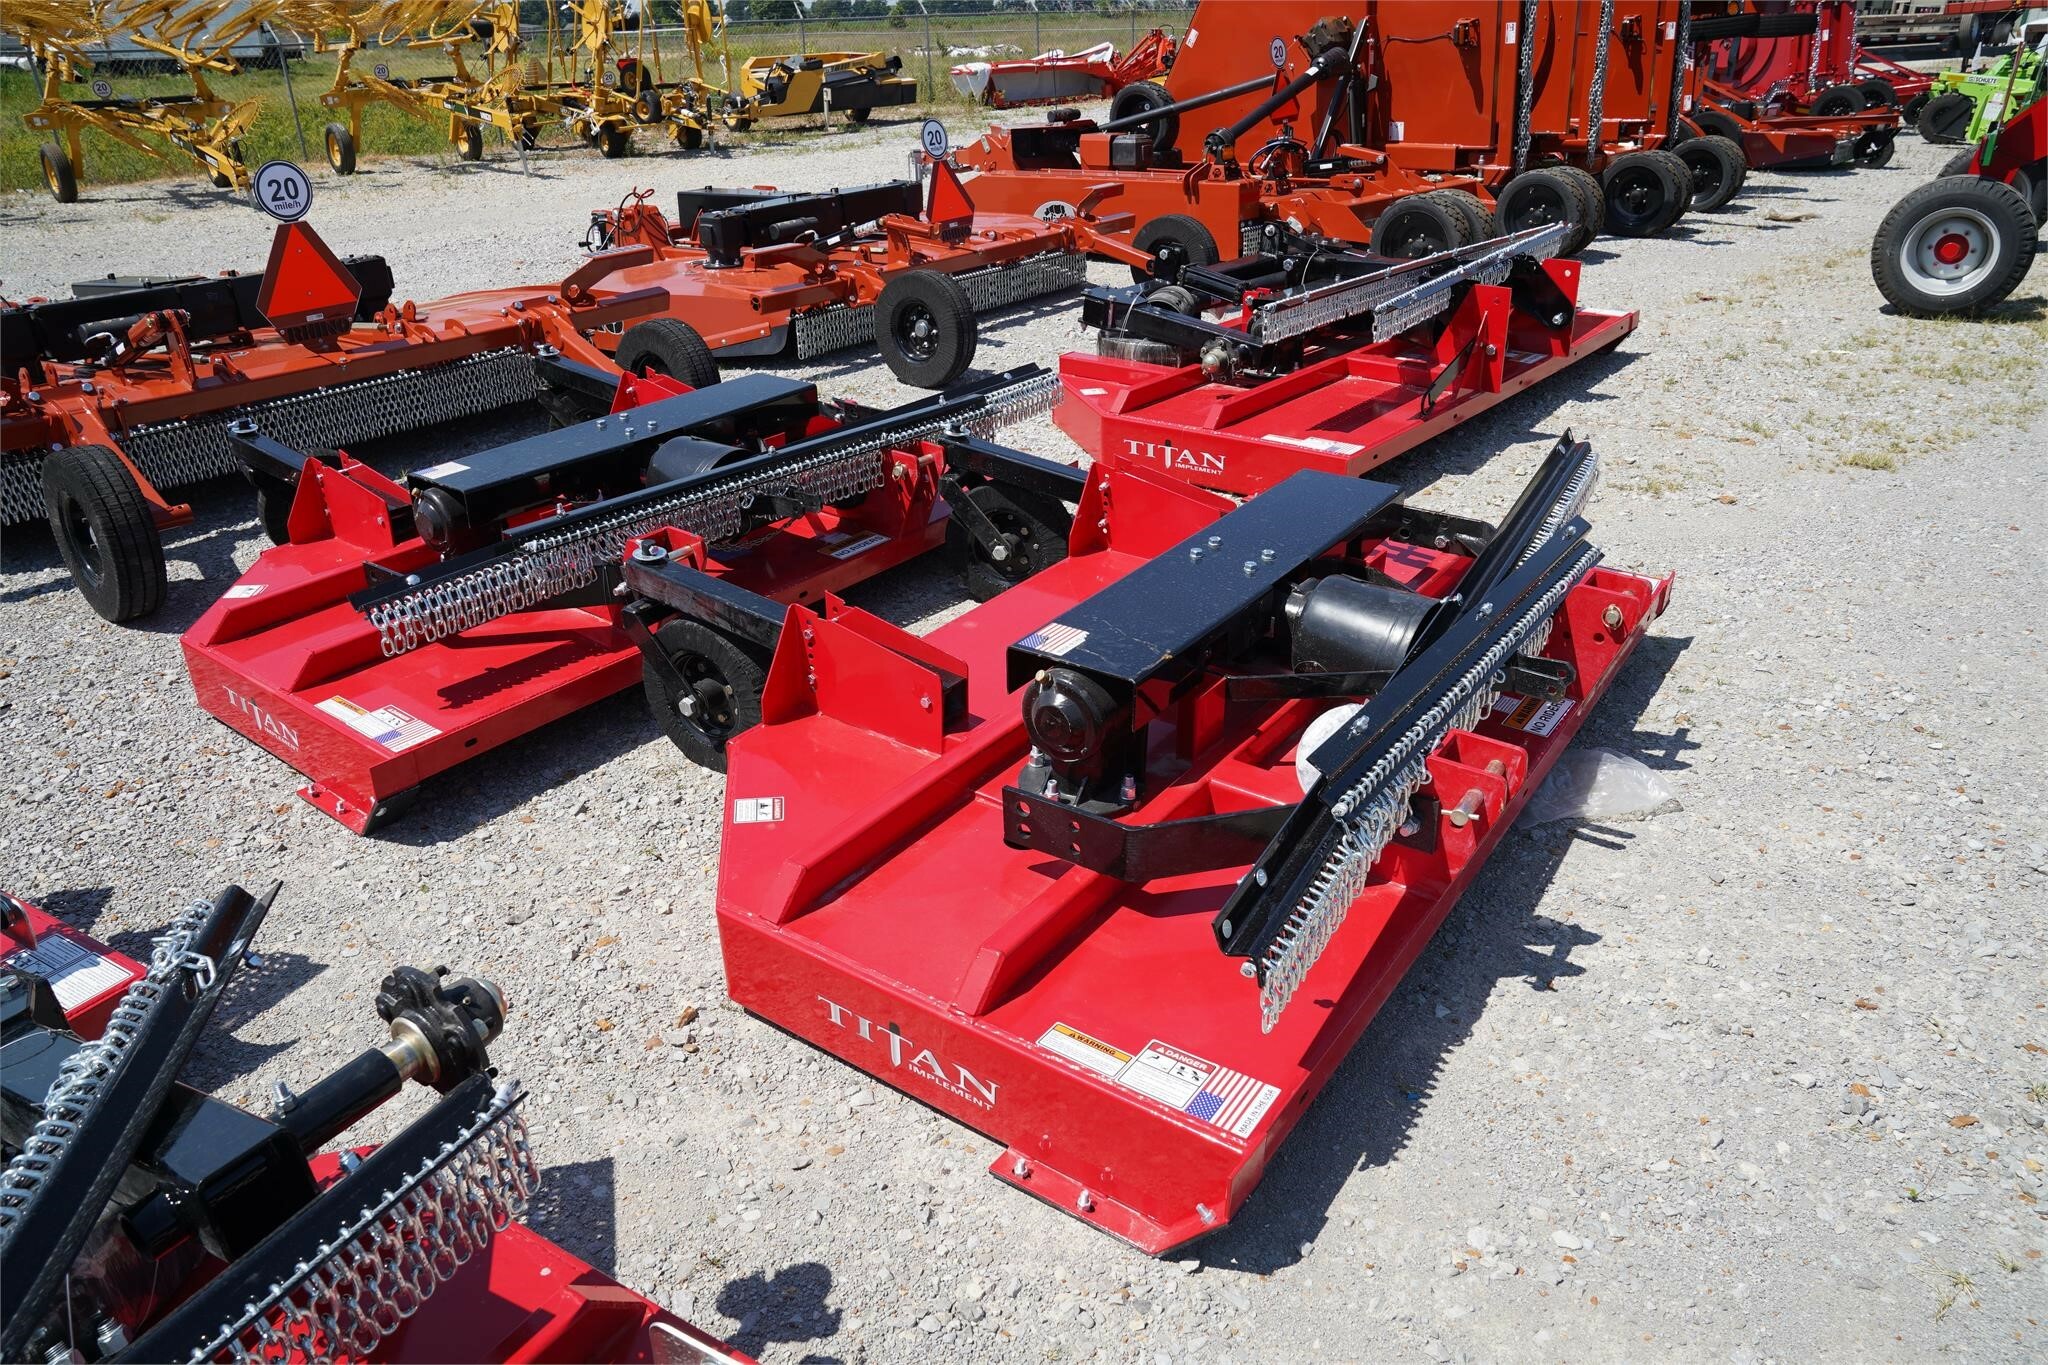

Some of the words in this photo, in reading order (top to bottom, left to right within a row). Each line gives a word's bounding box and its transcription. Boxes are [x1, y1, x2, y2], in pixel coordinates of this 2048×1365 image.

[1273, 45, 1284, 58] 20
[376, 66, 387, 75] 20
[95, 83, 108, 92] 20
[927, 130, 942, 146] 20
[267, 177, 299, 202] 20
[274, 200, 302, 211] mile/h
[1123, 439, 1226, 470] TITAN
[1174, 463, 1223, 476] IMPLEMENT
[222, 685, 299, 746] TITAN
[1529, 721, 1546, 733] NO
[817, 994, 999, 1104] TITAN
[1077, 1034, 1116, 1055] WARNING
[1165, 1049, 1207, 1070] DANGER
[908, 1064, 993, 1112] IMPLEMENT
[1238, 1116, 1255, 1133] MADE
